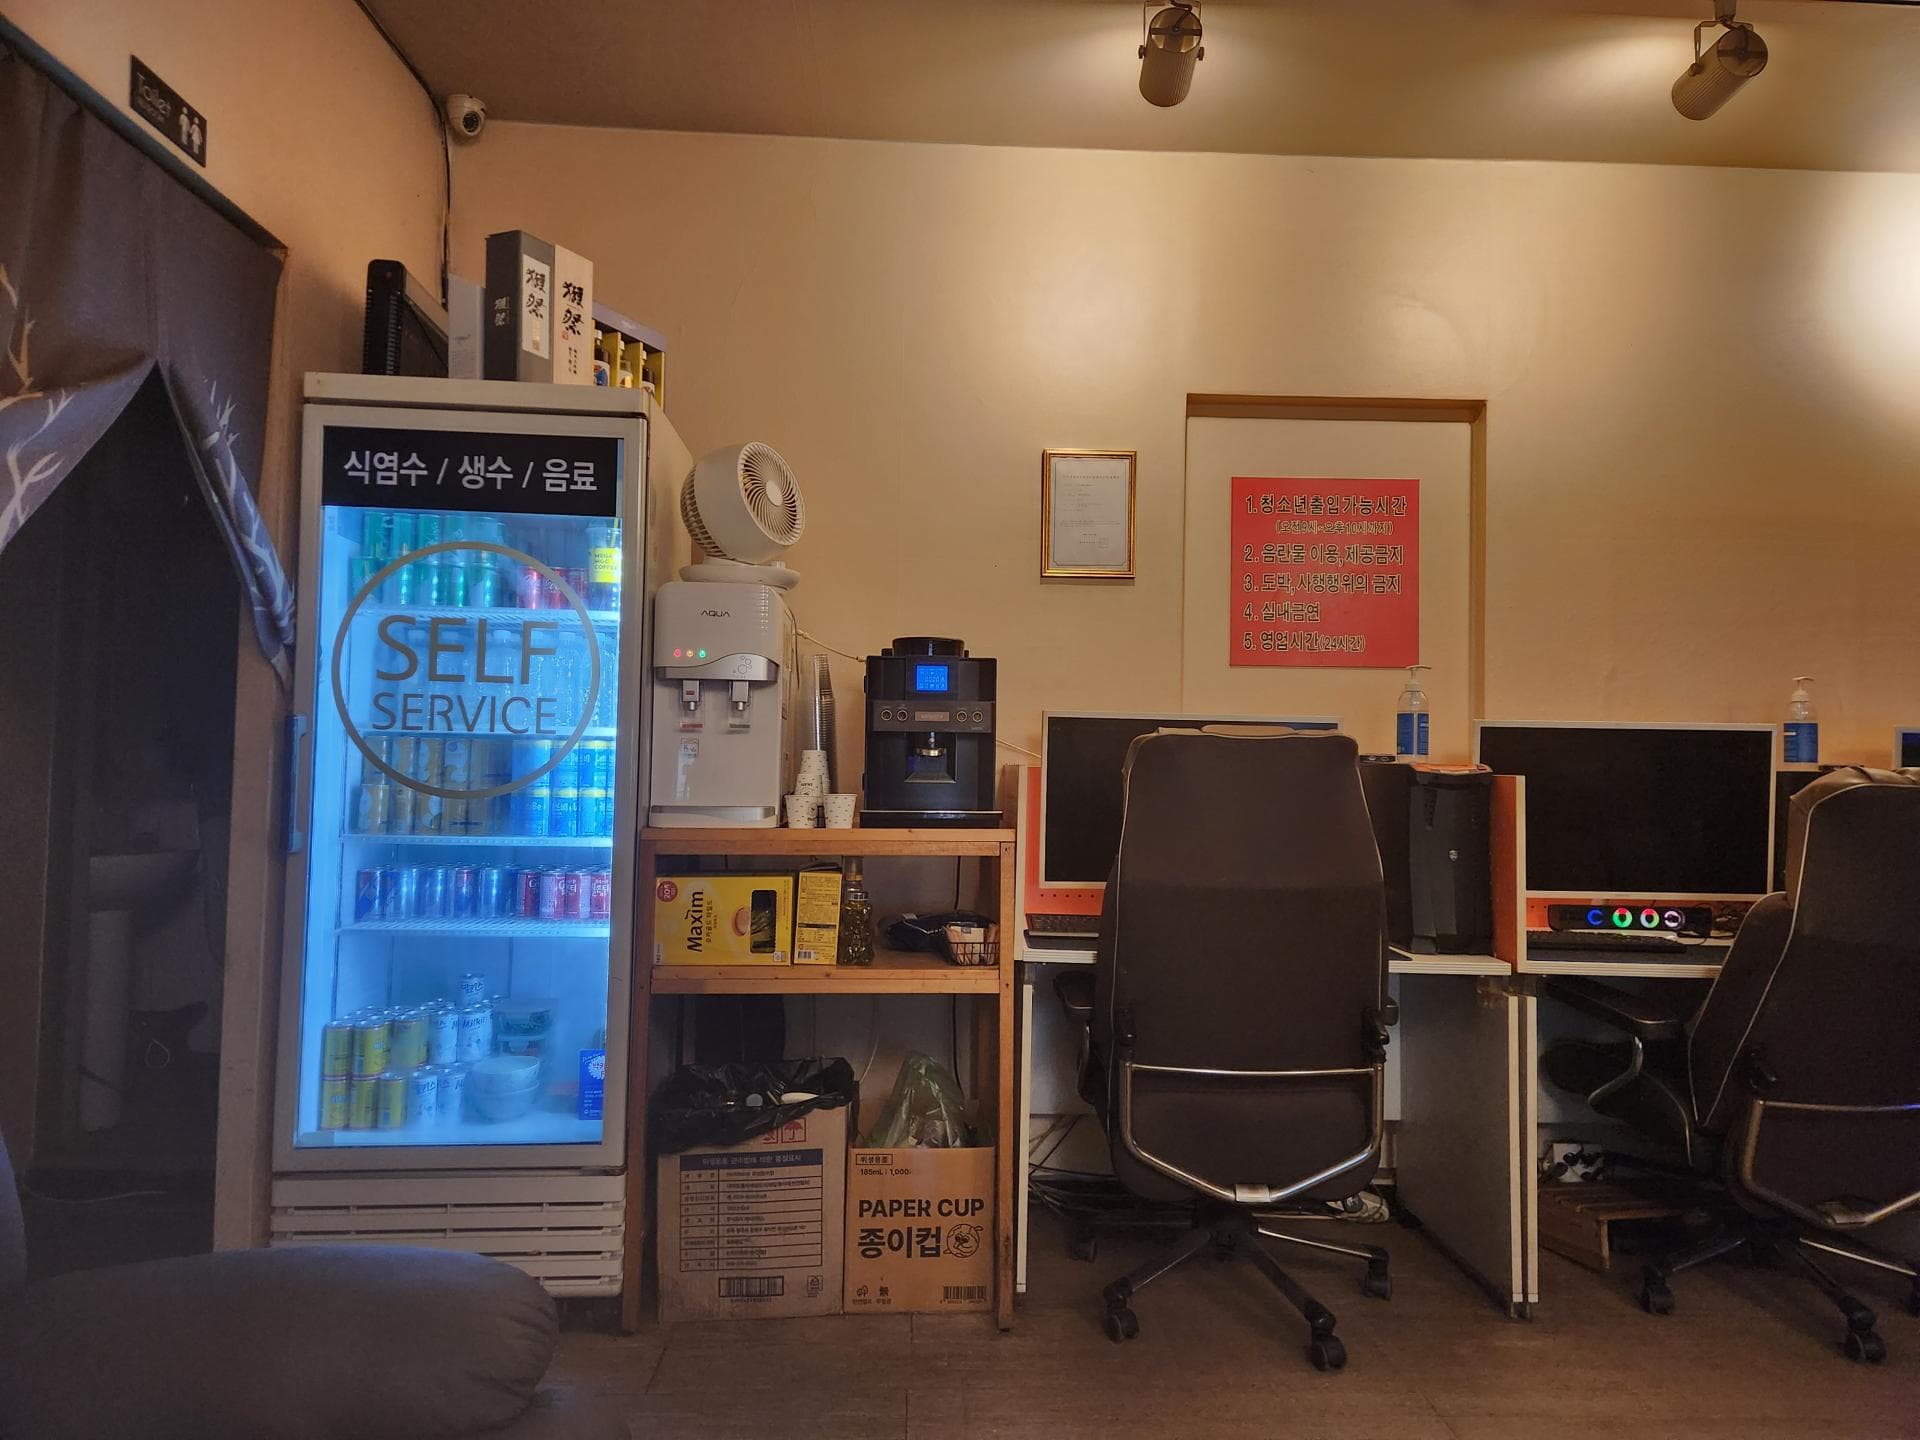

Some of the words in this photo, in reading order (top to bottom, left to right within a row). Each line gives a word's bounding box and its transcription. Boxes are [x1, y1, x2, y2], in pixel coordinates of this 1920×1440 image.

[344, 450, 428, 487] 식염수
[458, 455, 514, 490] 생수
[542, 457, 598, 492] 음료
[1262, 543, 1306, 564] 음란물
[1372, 574, 1402, 594] 금지
[701, 610, 731, 618] AQUA
[1262, 602, 1320, 622] 실내금연
[376, 614, 560, 685] SELF
[372, 691, 557, 735] SERVICE
[686, 889, 704, 953] Maxim
[858, 1198, 931, 1218] PAPER
[937, 1198, 985, 1218] CUP
[857, 1226, 942, 1259] 종이컵
